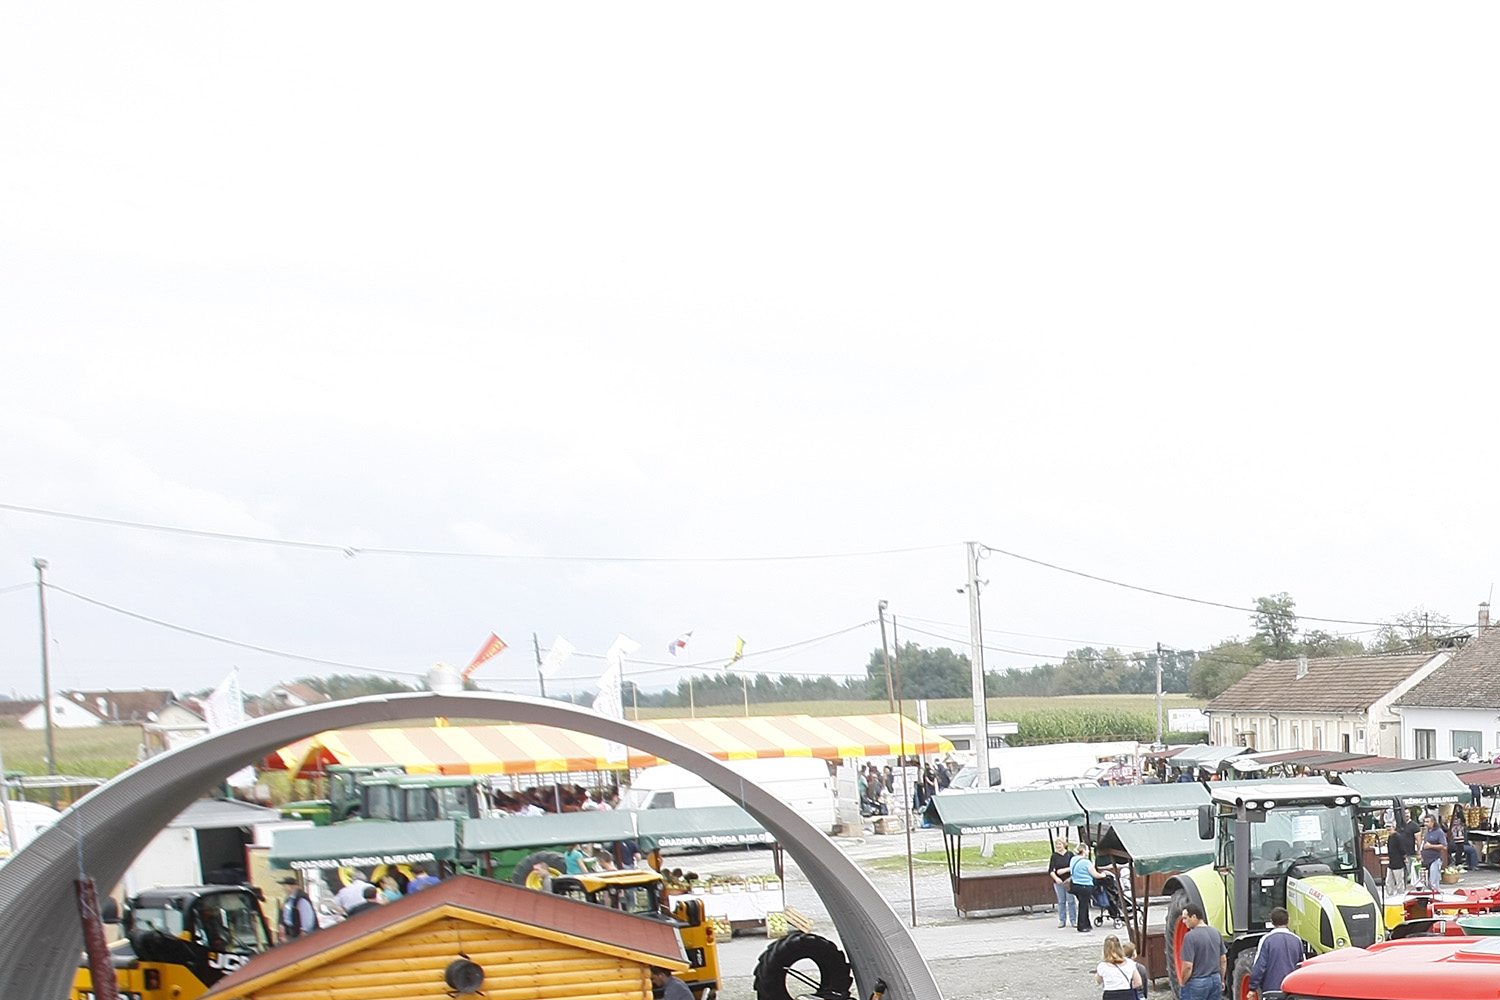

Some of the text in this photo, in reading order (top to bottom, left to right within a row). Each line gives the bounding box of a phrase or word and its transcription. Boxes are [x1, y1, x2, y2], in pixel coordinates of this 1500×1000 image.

[1427, 796, 1459, 804] BJELOVAR
[1103, 812, 1138, 821] GRADSKA
[1169, 808, 1200, 817] BJELOV
[960, 820, 1069, 835] GRADSKA TRŽNICA BJELOVAR
[658, 831, 776, 847] GRADSKA TRŽNICA BJELO
[290, 859, 340, 871] GRADSKA
[383, 852, 436, 865] BJELOVAR
